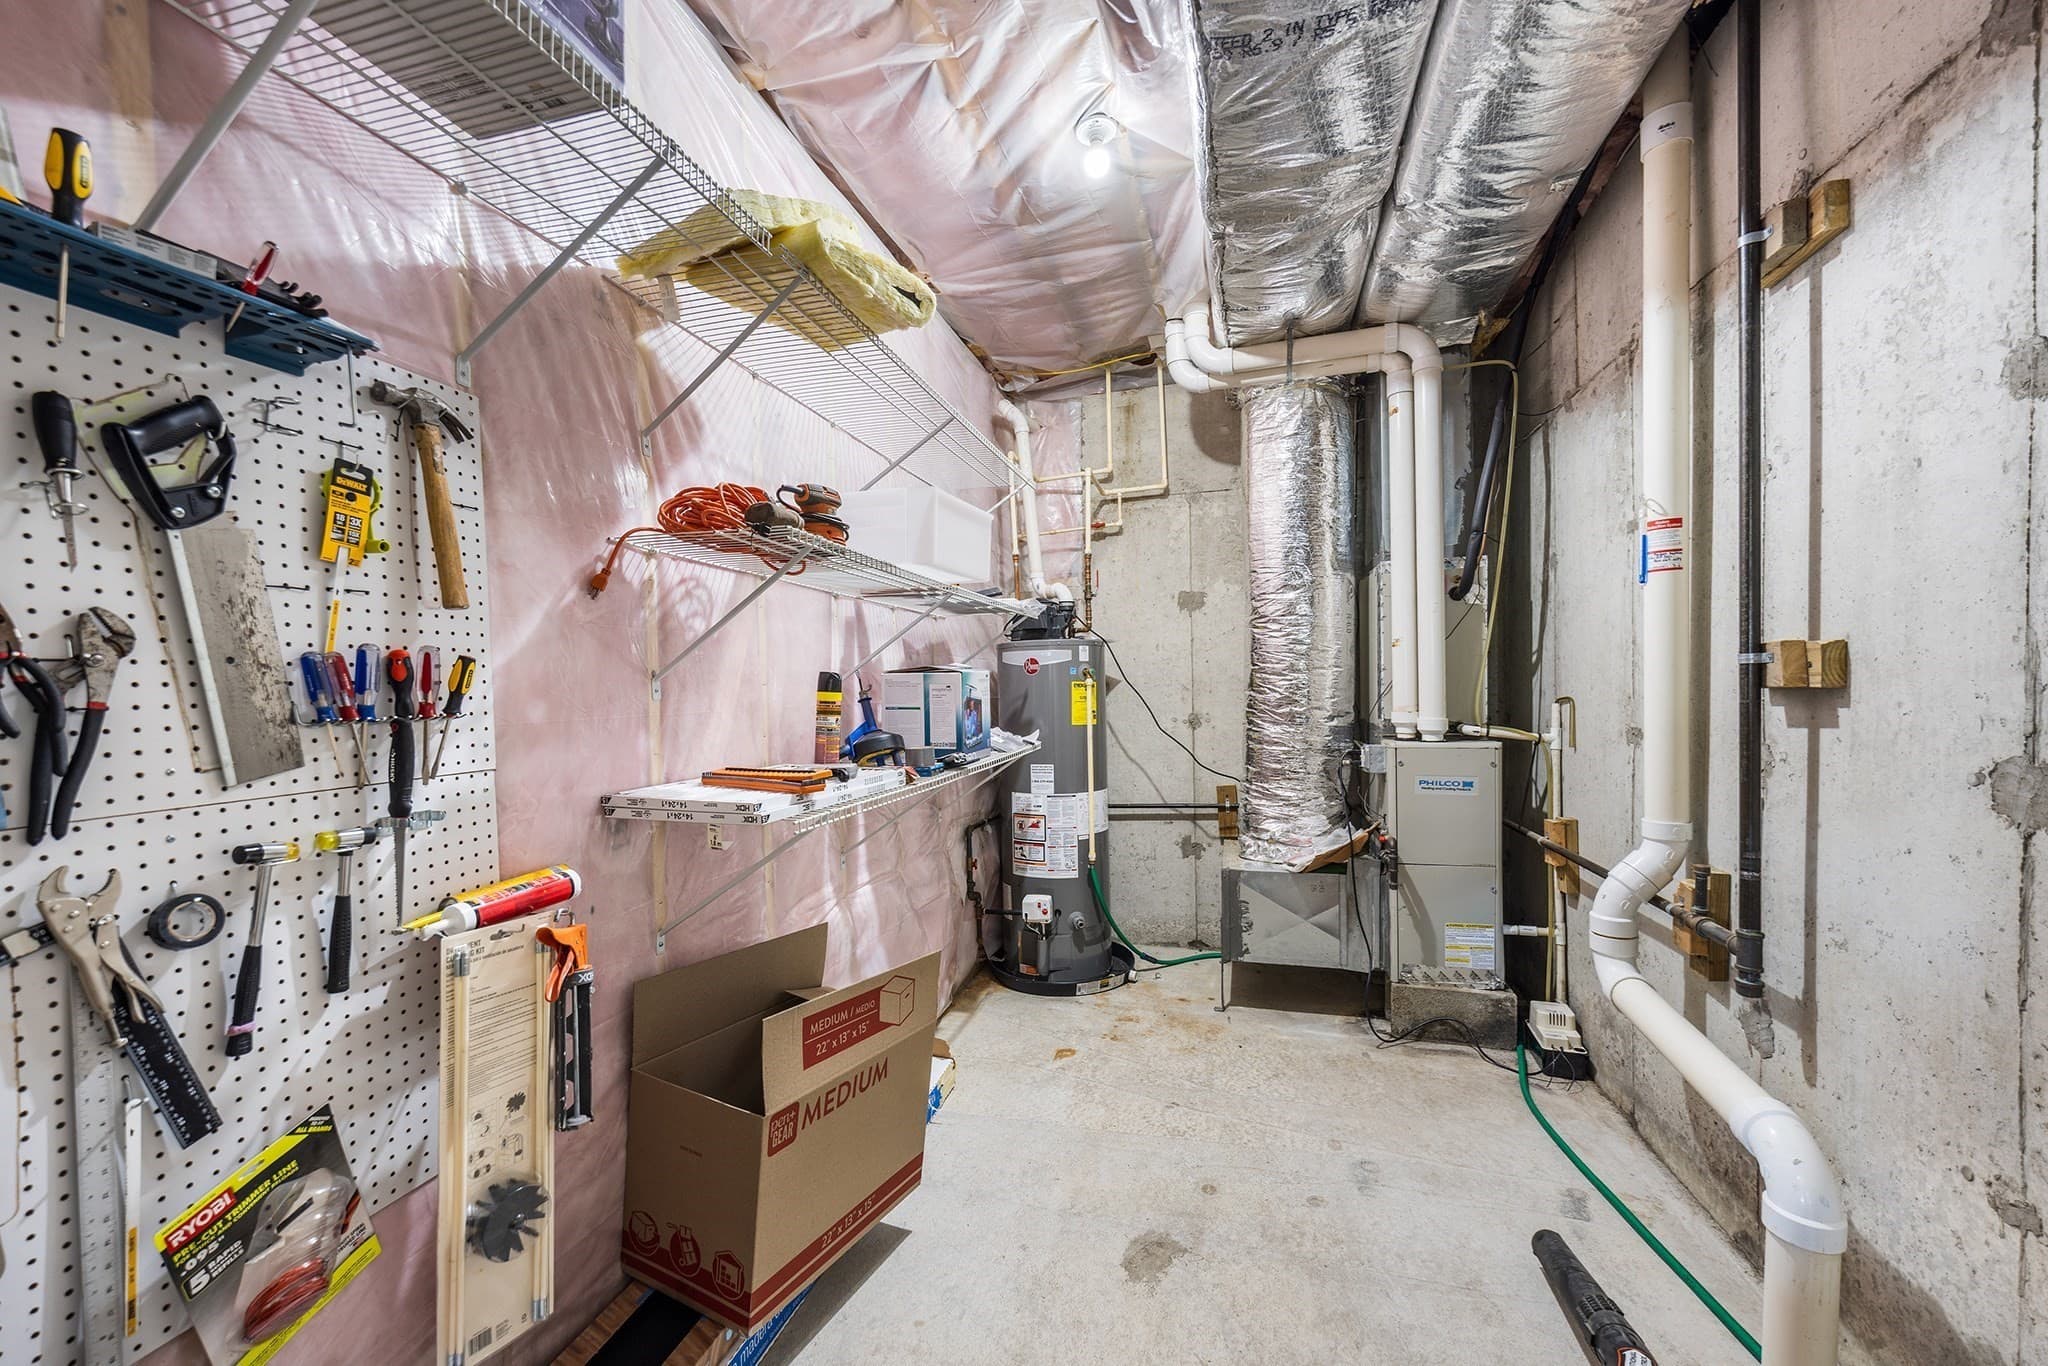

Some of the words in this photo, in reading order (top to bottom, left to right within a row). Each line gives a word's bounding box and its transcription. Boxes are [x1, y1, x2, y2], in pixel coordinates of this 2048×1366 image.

[1263, 28, 1274, 41] 2
[1285, 19, 1305, 36] IN
[1418, 779, 1460, 787] PHILCO
[735, 804, 750, 812] HDX
[743, 816, 758, 824] HDX
[810, 1010, 849, 1035] MEDIUM
[850, 1005, 854, 1017] /
[855, 999, 876, 1015] MEDIO
[816, 1039, 831, 1056] 22"
[832, 1038, 837, 1048] x
[839, 1030, 850, 1044] 13"
[852, 1030, 857, 1039] x
[859, 1020, 870, 1035] 15"
[801, 1057, 888, 1130] MEDIUM
[772, 1121, 794, 1148] GEAR
[167, 1192, 233, 1248] RYOBI
[172, 1219, 224, 1263] PRE-CUT
[225, 1179, 271, 1221] TRIMMER
[272, 1159, 299, 1181] LINE
[180, 1234, 225, 1277] .095"
[189, 1268, 211, 1296] 5
